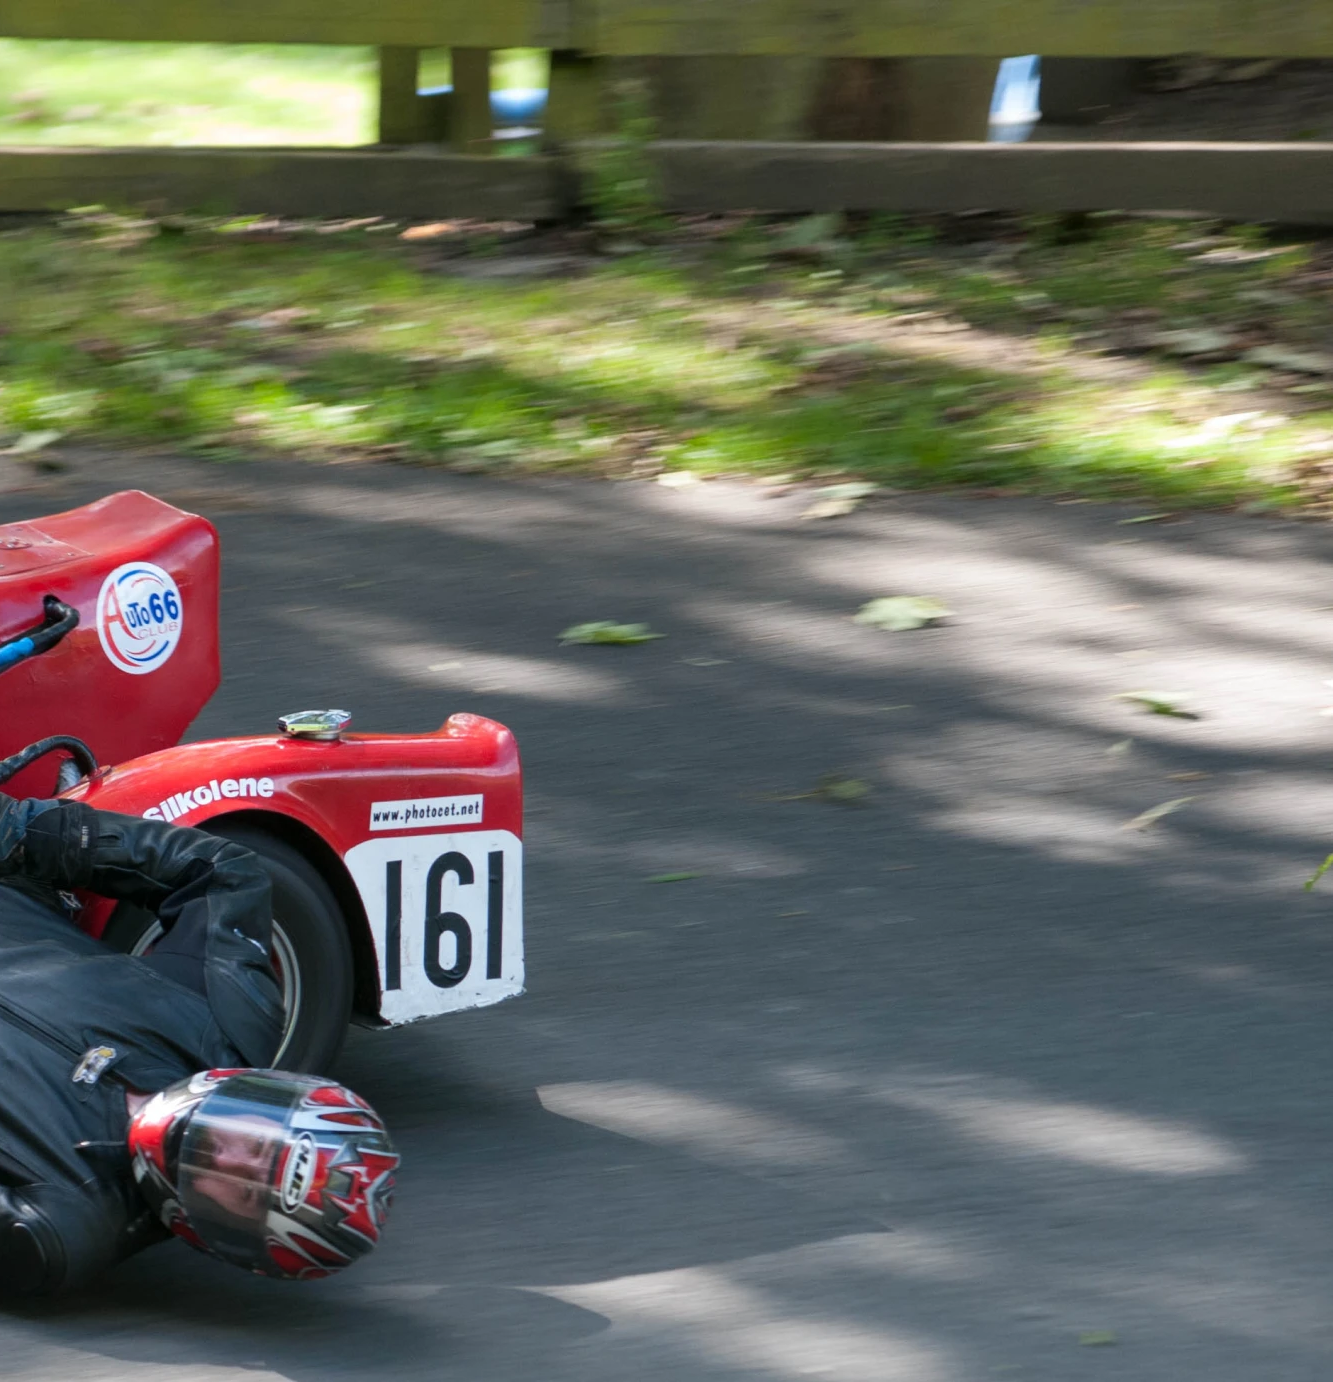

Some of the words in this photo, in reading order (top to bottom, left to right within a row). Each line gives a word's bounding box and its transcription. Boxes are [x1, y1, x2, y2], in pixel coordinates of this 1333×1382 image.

[137, 621, 179, 640] CLUB
[142, 777, 275, 823] Silkolene
[372, 803, 480, 825] www.photocet.net
[385, 850, 504, 991] 161
